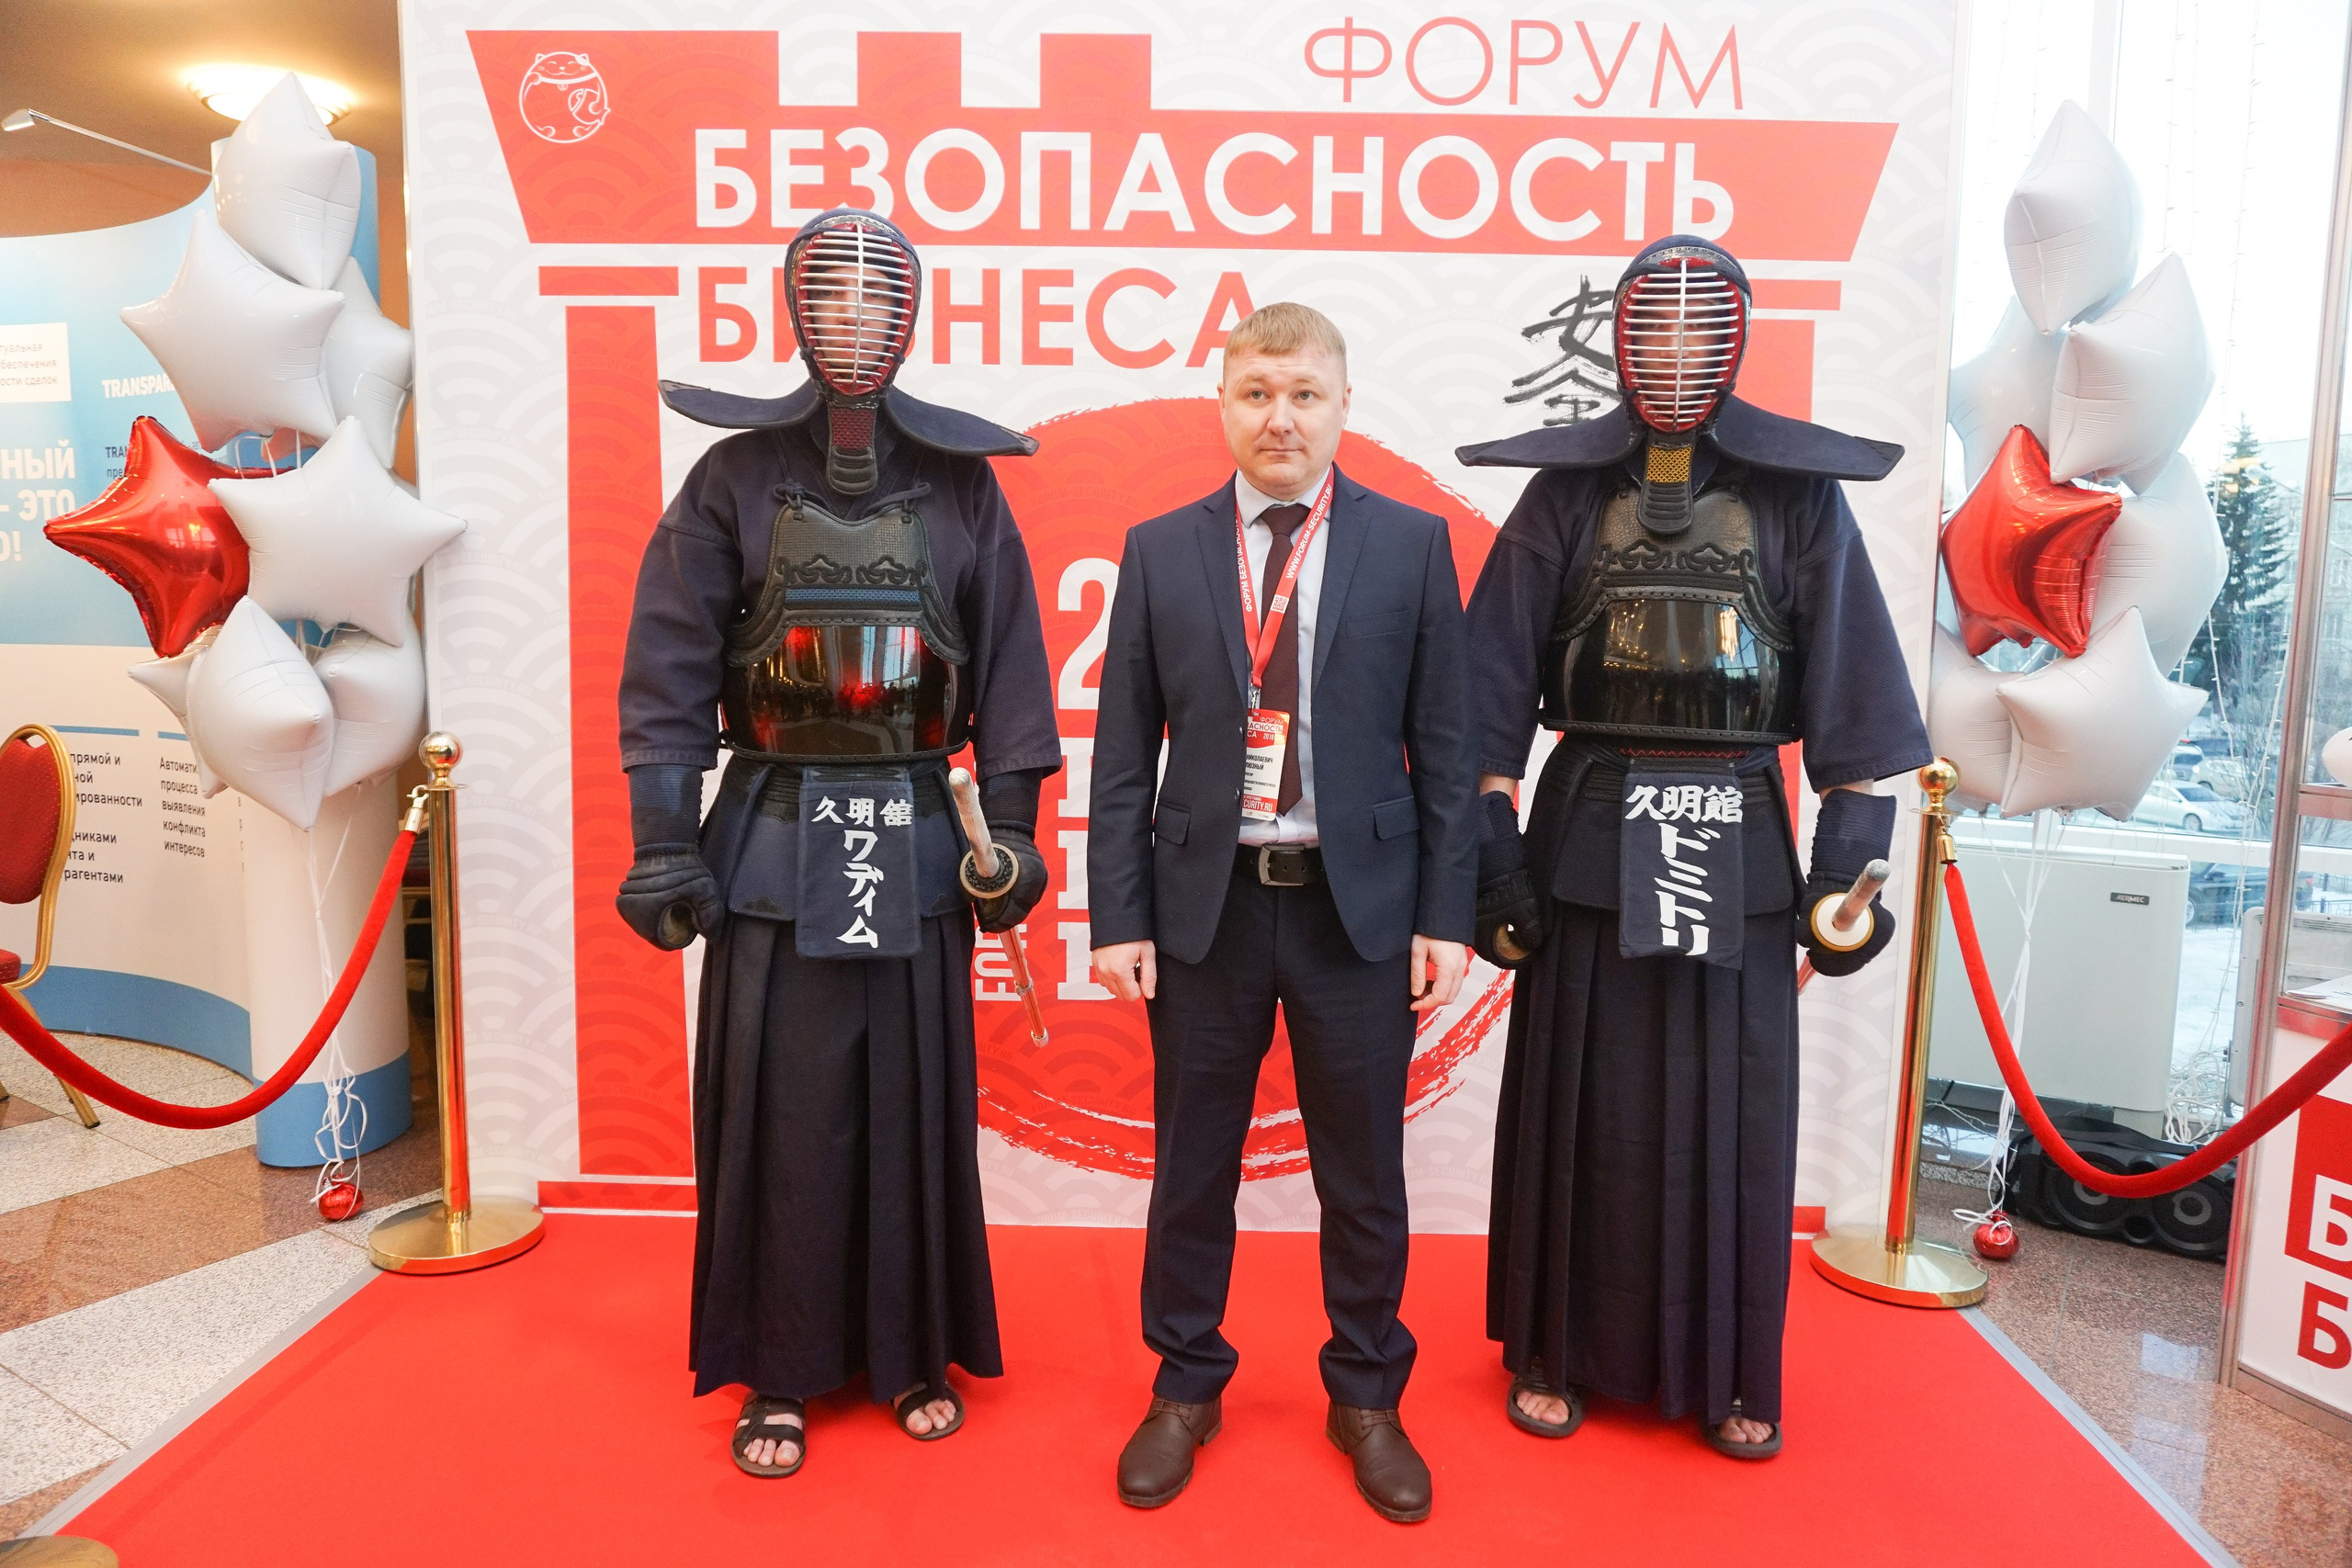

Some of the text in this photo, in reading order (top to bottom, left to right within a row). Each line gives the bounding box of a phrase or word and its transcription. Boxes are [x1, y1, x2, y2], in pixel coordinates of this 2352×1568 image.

[1304, 16, 1744, 111] ФОРУМ
[695, 127, 1736, 243] БЕЗОПАСНОСТЬ
[697, 265, 1256, 370] БНЕСА
[25, 377, 58, 387] сделок
[101, 373, 175, 398] TRANSPAR
[0, 439, 75, 479] НЫЙ
[17, 489, 75, 521] ЭТО
[1285, 483, 1333, 579] WWW.FORUM-SECURITY.RU
[1240, 581, 1253, 613] ФОРУМ
[1248, 722, 1283, 733] АСНОСТЬ
[1260, 716, 1283, 726] ФОРУМ
[115, 756, 121, 766] и
[159, 756, 198, 773] Автомати
[161, 780, 198, 795] процесса
[162, 799, 206, 818] выявления
[1243, 798, 1273, 812] CURITY.RU
[1624, 784, 1744, 823] 久明館
[73, 831, 118, 844] никами
[163, 819, 206, 838] конфликта
[88, 852, 96, 862] и
[164, 840, 205, 858] интересов
